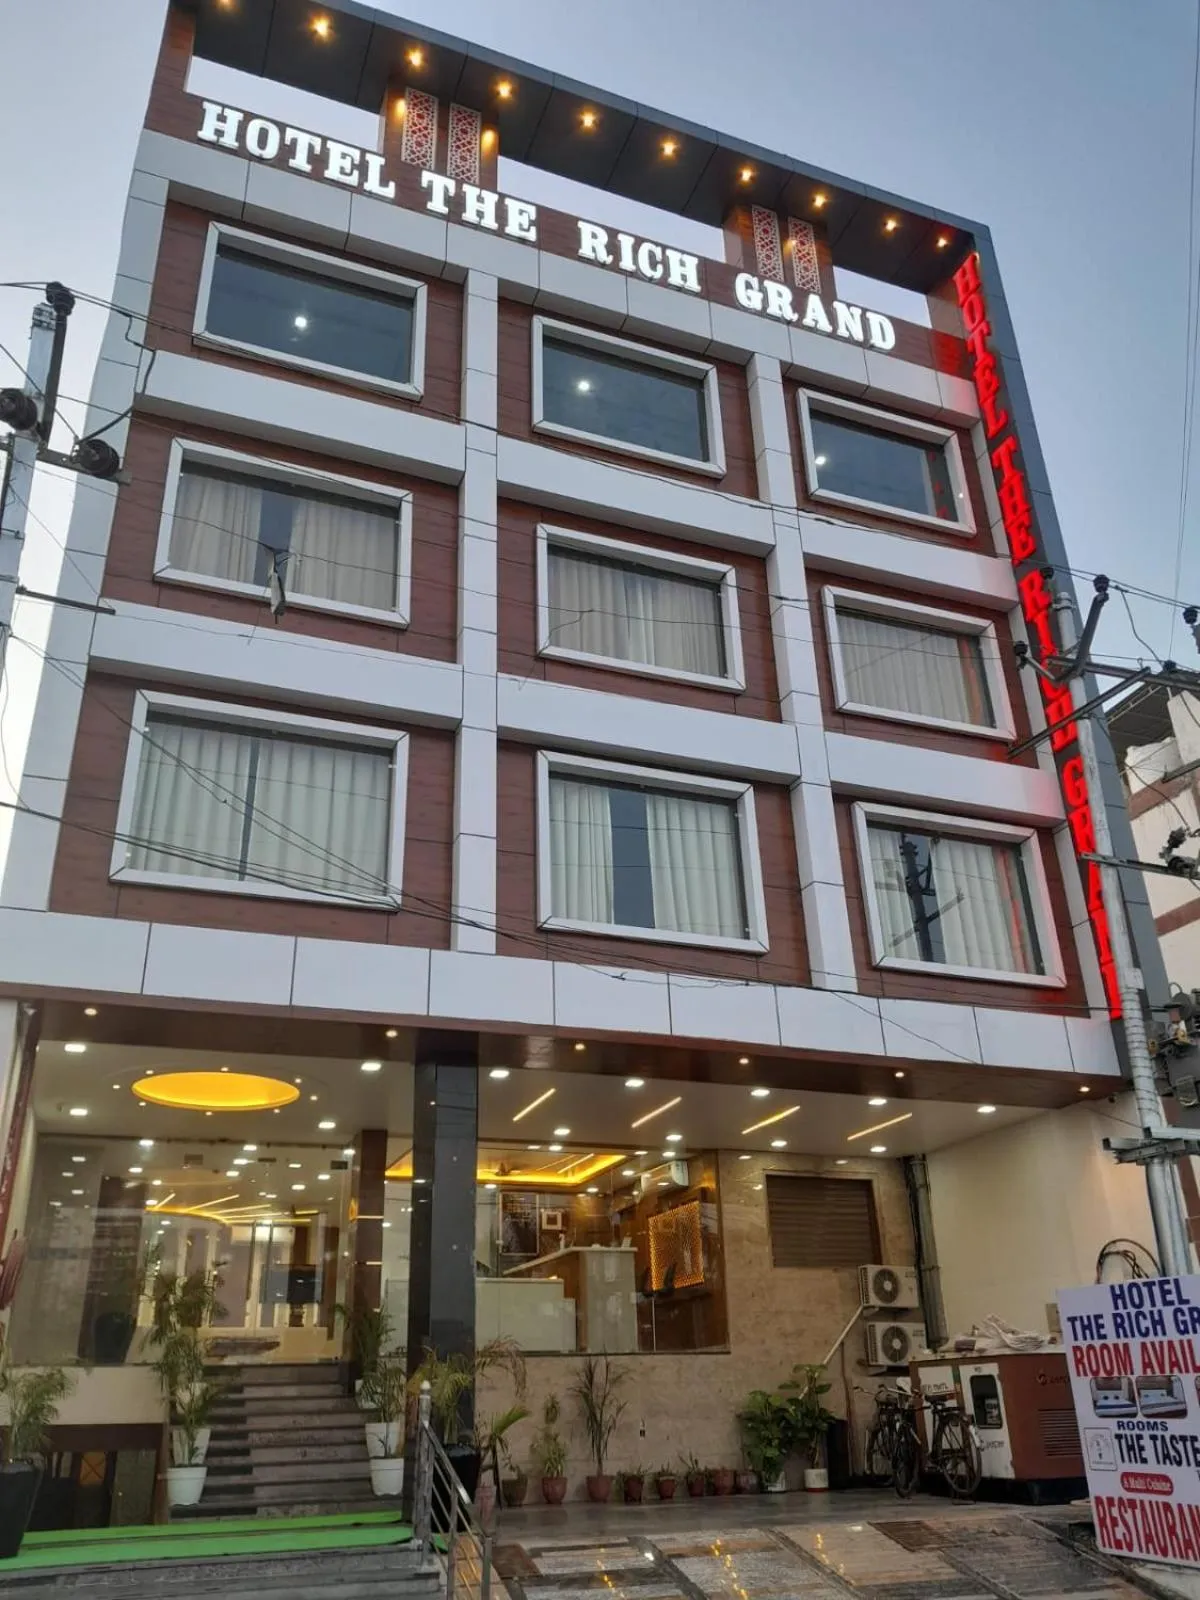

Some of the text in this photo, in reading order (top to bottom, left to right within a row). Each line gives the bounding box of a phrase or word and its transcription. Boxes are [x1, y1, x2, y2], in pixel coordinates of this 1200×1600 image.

[198, 101, 897, 351] HOTEL THE RICH GRAND
[953, 252, 1009, 439] HOTEL
[992, 435, 1036, 566] THE
[1110, 1278, 1191, 1311] HOTEL
[1067, 1315, 1107, 1341] THE
[1112, 1310, 1167, 1340] RICH
[1072, 1340, 1200, 1377] ROOM AVAIL
[1117, 1420, 1169, 1432] ROOMS
[1115, 1433, 1149, 1465] THE
[1149, 1434, 1200, 1468] TASTE
